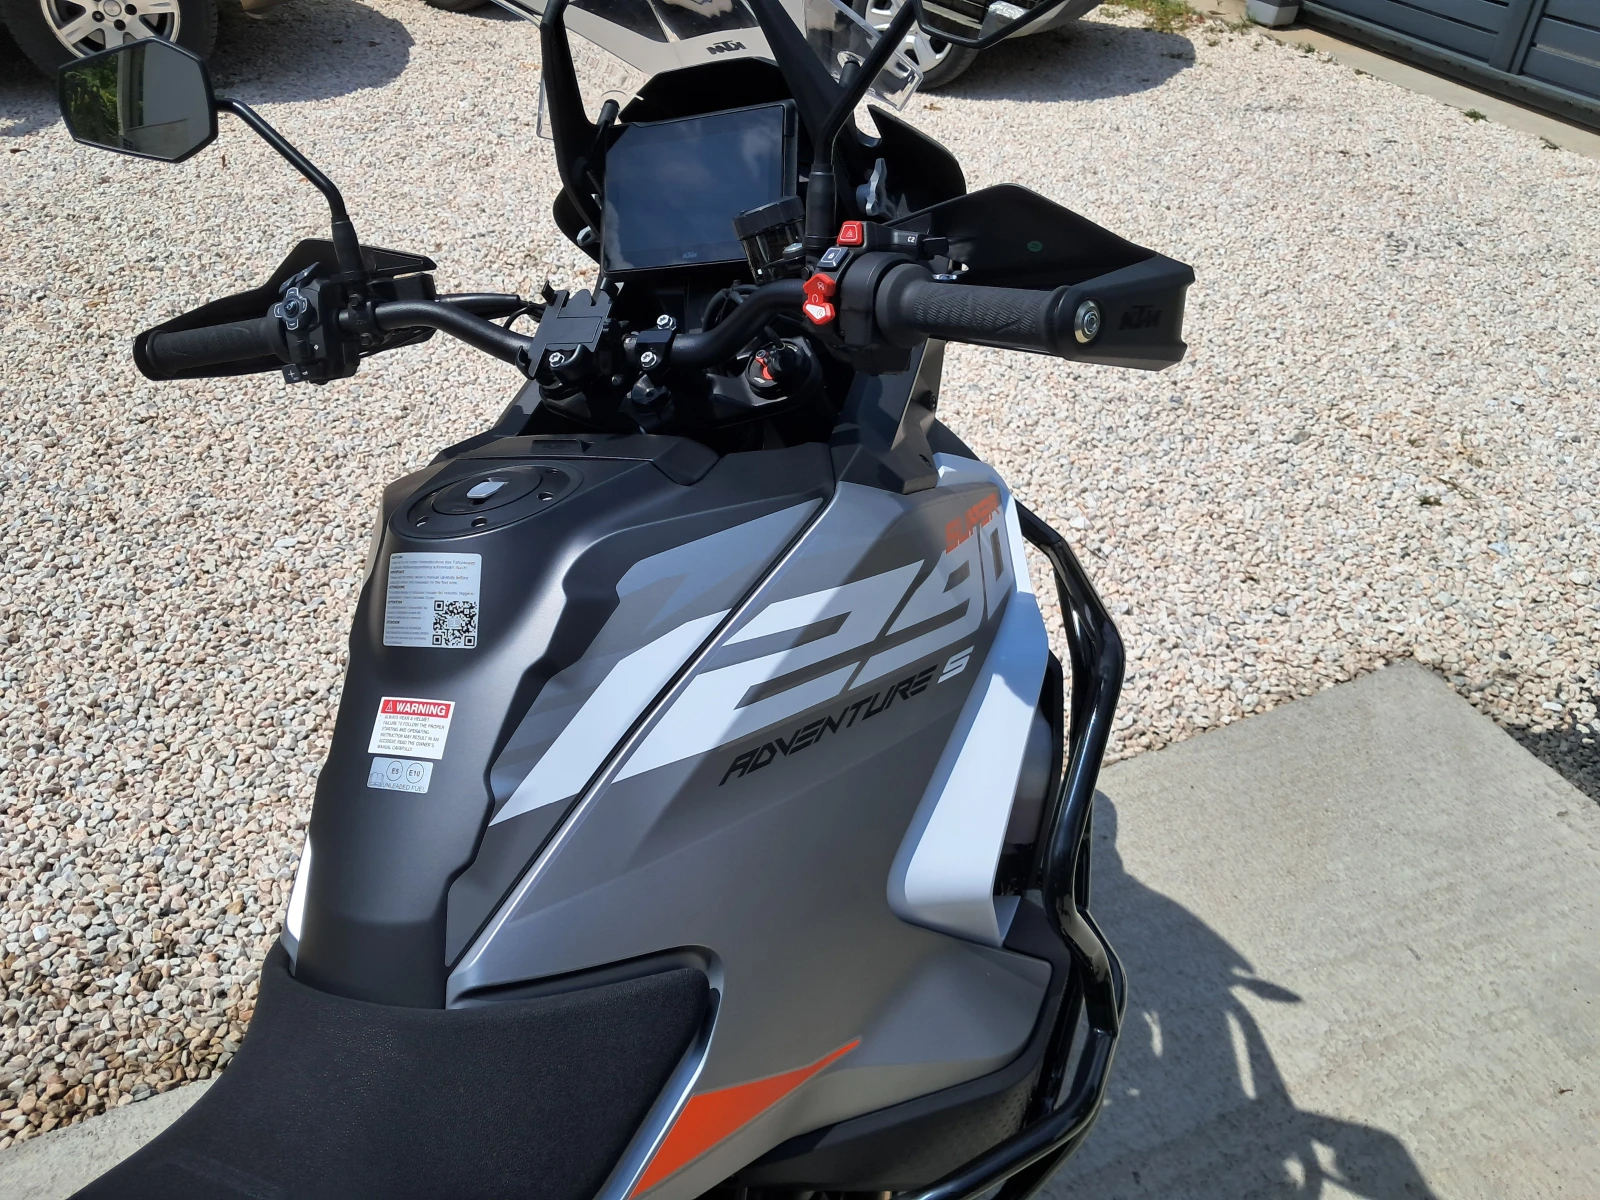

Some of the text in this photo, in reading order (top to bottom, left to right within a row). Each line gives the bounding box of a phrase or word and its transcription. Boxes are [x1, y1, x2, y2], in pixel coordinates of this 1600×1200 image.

[1118, 304, 1163, 331] KTM
[396, 702, 446, 715] WARNING
[718, 645, 975, 787] ADVENTURE S
[408, 769, 421, 777] E10
[381, 782, 426, 793] UNLEADED FUEL
